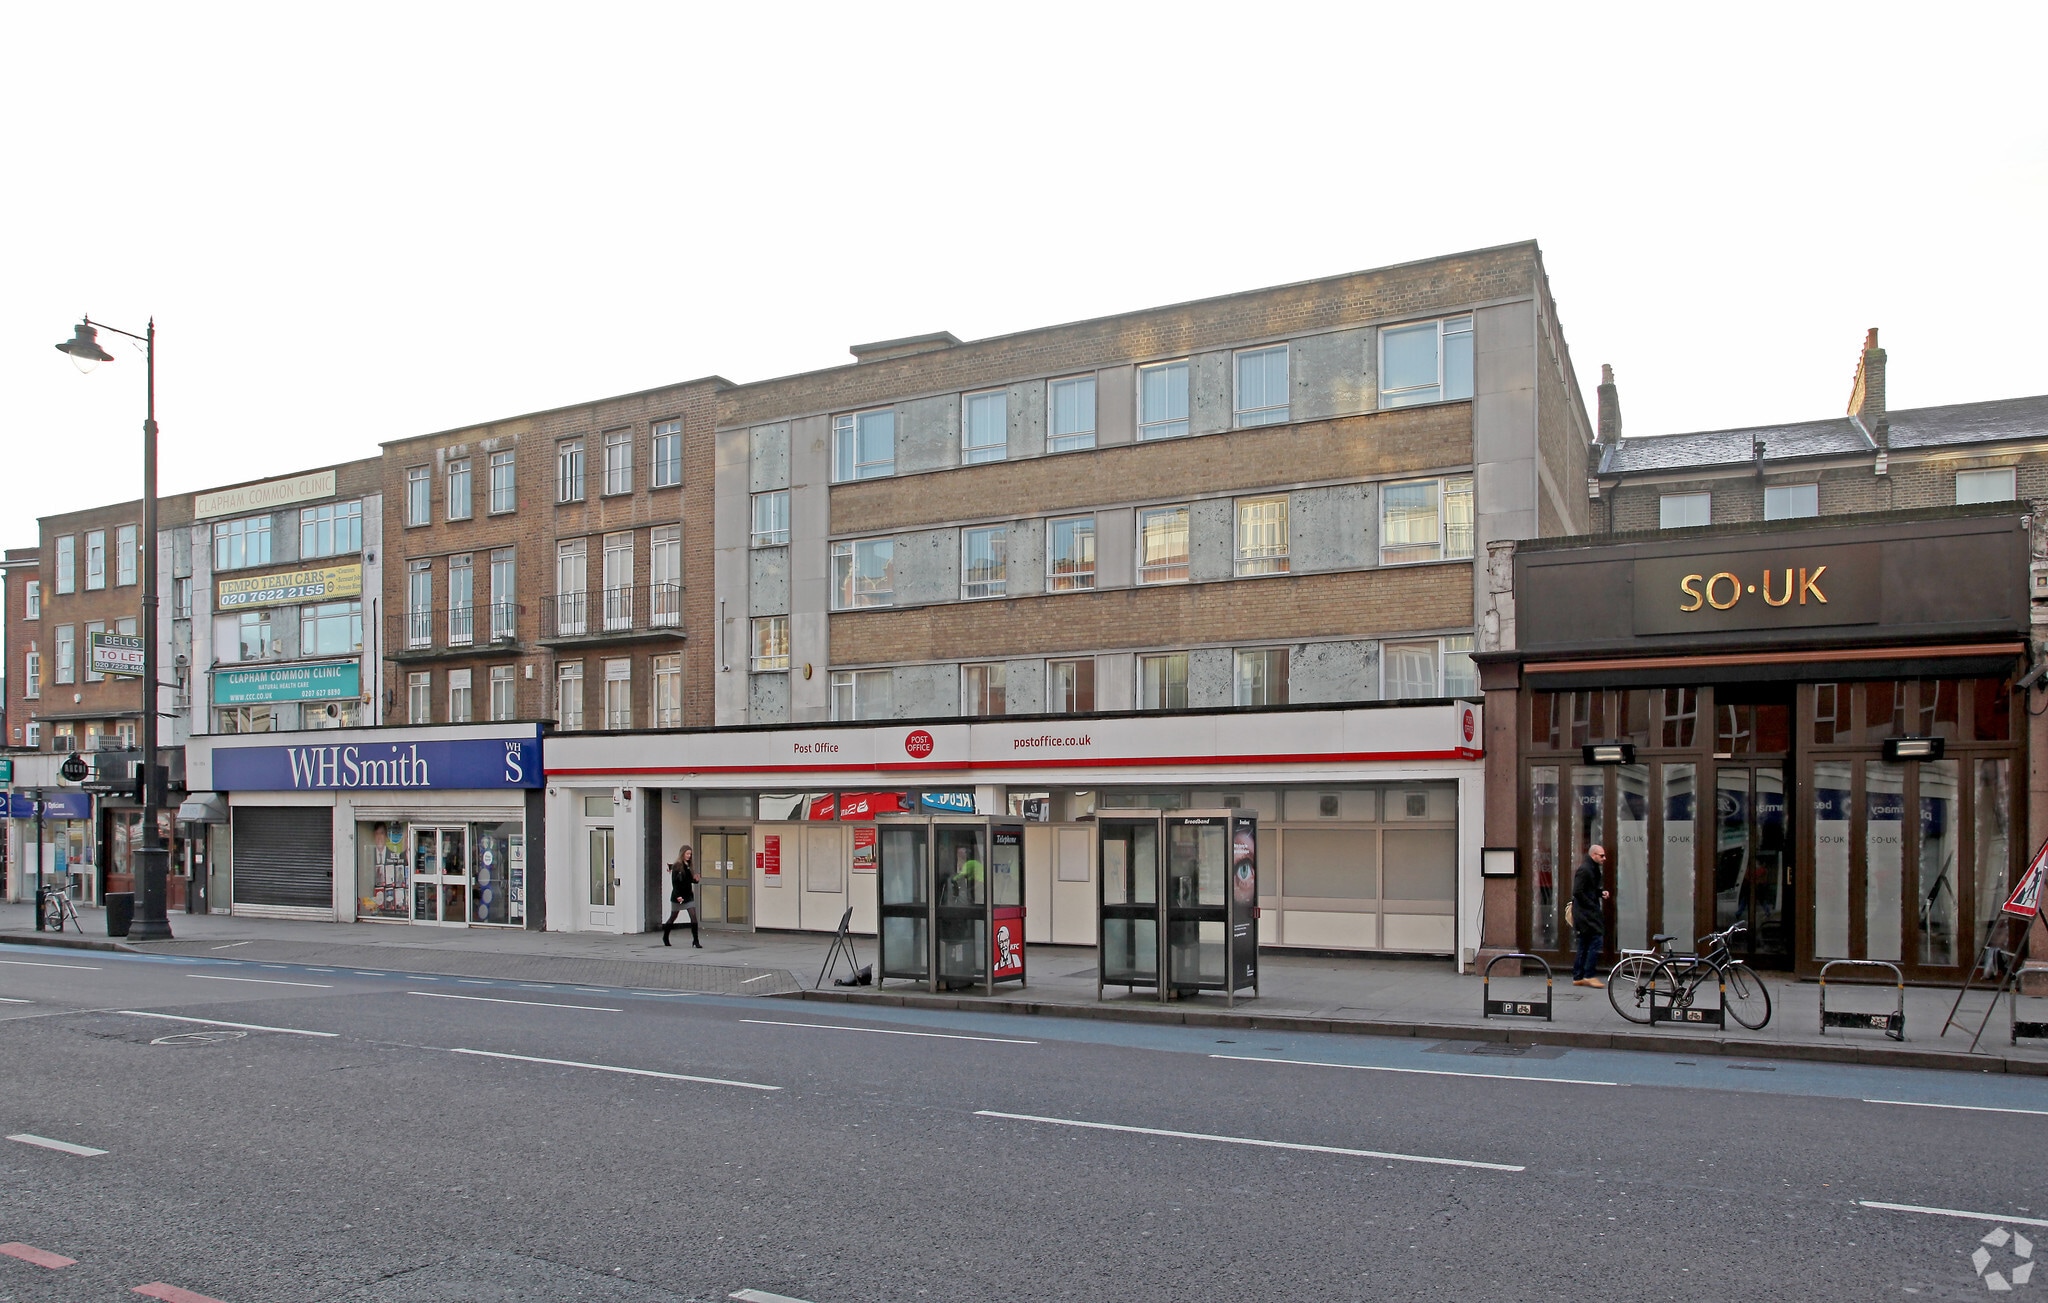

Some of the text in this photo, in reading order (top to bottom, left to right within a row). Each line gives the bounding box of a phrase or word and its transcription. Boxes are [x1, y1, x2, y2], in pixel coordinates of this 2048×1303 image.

[198, 476, 332, 514] CLAPHAM COMMON CLINIC
[221, 570, 324, 594] TEMPO TEAM CARS
[221, 594, 246, 605] 020
[250, 588, 284, 603] 7622
[288, 584, 324, 597] 2155
[104, 635, 139, 648] BELLS
[100, 650, 144, 662] TO LET
[229, 667, 341, 684] CLAPHAM COMMON CLINIC
[301, 690, 315, 698] 0207
[505, 741, 521, 751] WH
[910, 735, 928, 744] POST
[1013, 734, 1092, 749] postoffice.co.uk
[793, 742, 839, 753] Post Office
[907, 742, 931, 752] OFFICE
[287, 744, 431, 788] WHSmith
[505, 751, 523, 783] S
[996, 834, 1017, 845] Telephone
